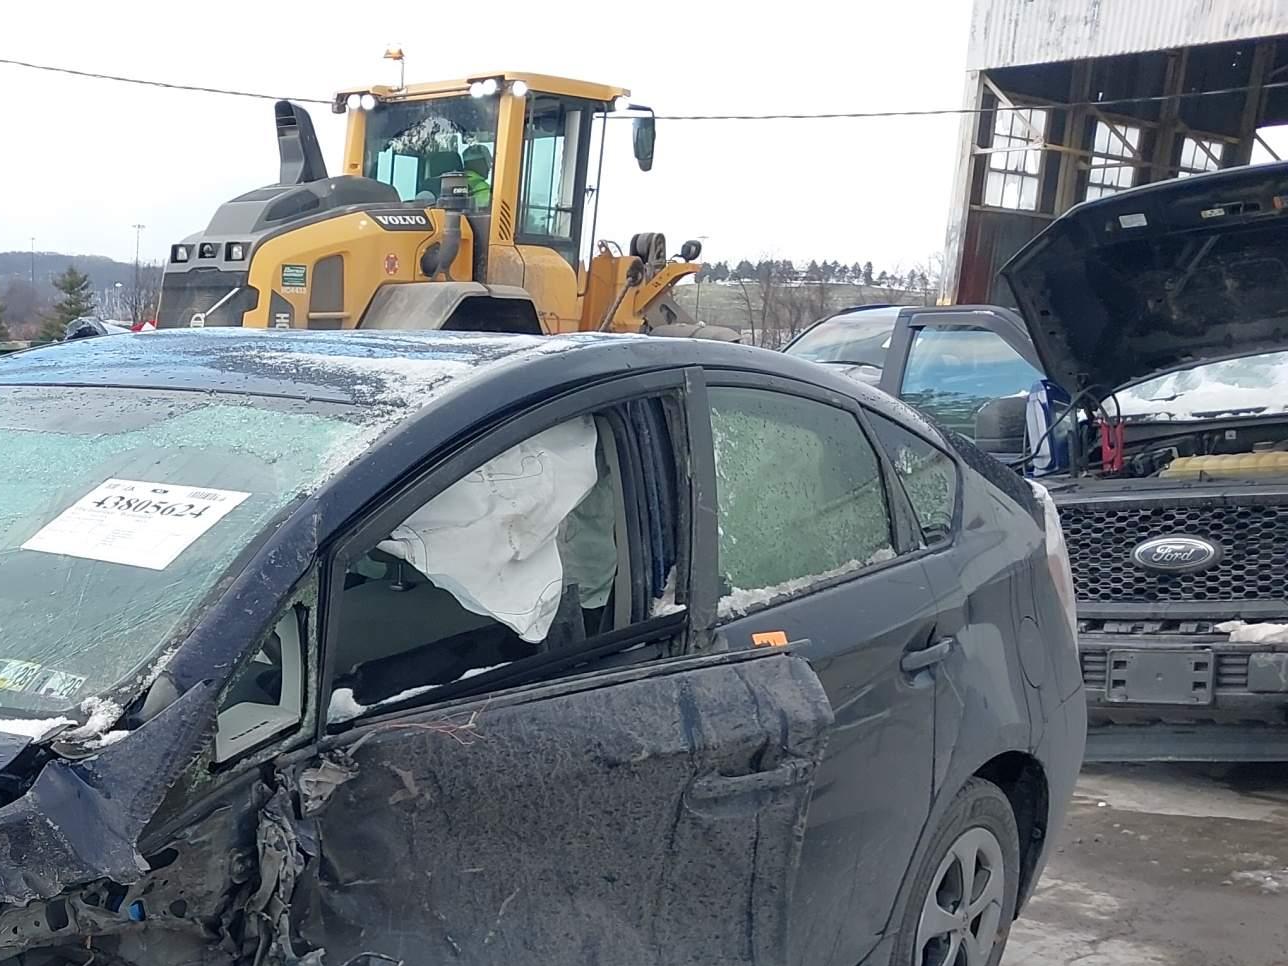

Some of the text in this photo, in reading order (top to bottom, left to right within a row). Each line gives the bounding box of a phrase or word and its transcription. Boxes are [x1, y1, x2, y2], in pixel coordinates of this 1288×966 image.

[375, 215, 427, 225] VOLVO
[92, 495, 211, 519] 43805624
[1152, 544, 1196, 562] Ford
